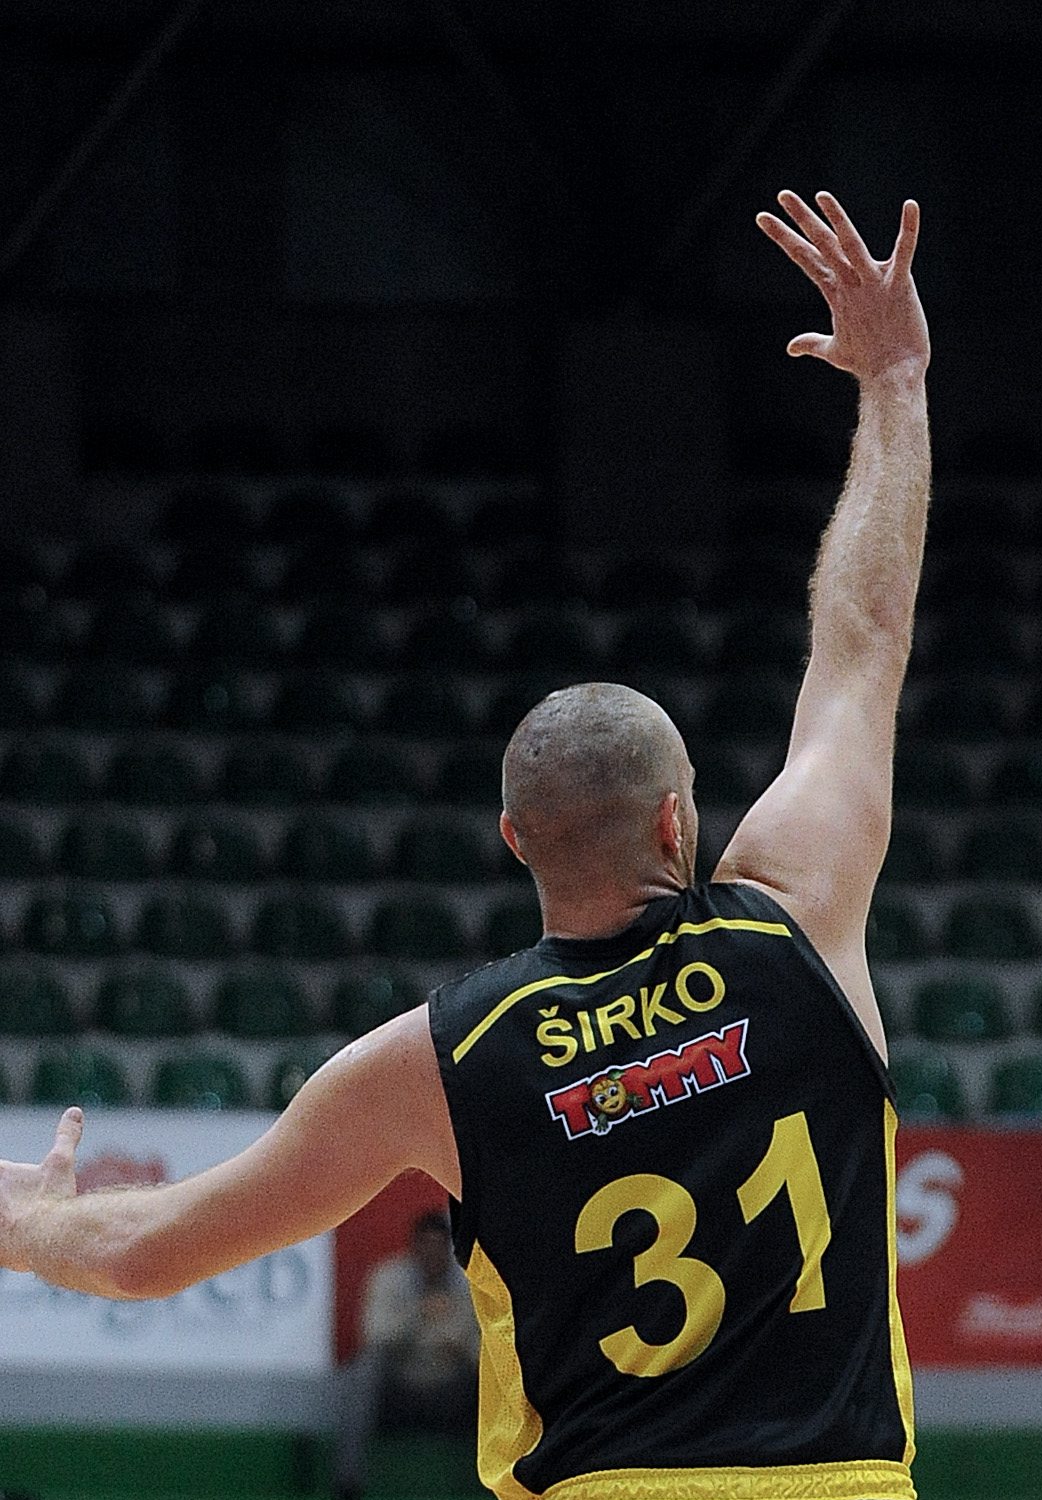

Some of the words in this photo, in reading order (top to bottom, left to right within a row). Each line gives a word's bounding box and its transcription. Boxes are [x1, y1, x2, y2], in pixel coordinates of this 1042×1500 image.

[536, 961, 726, 1068] ŠIRKO
[545, 1018, 752, 1141] TOMMY
[574, 1111, 832, 1378] 31
